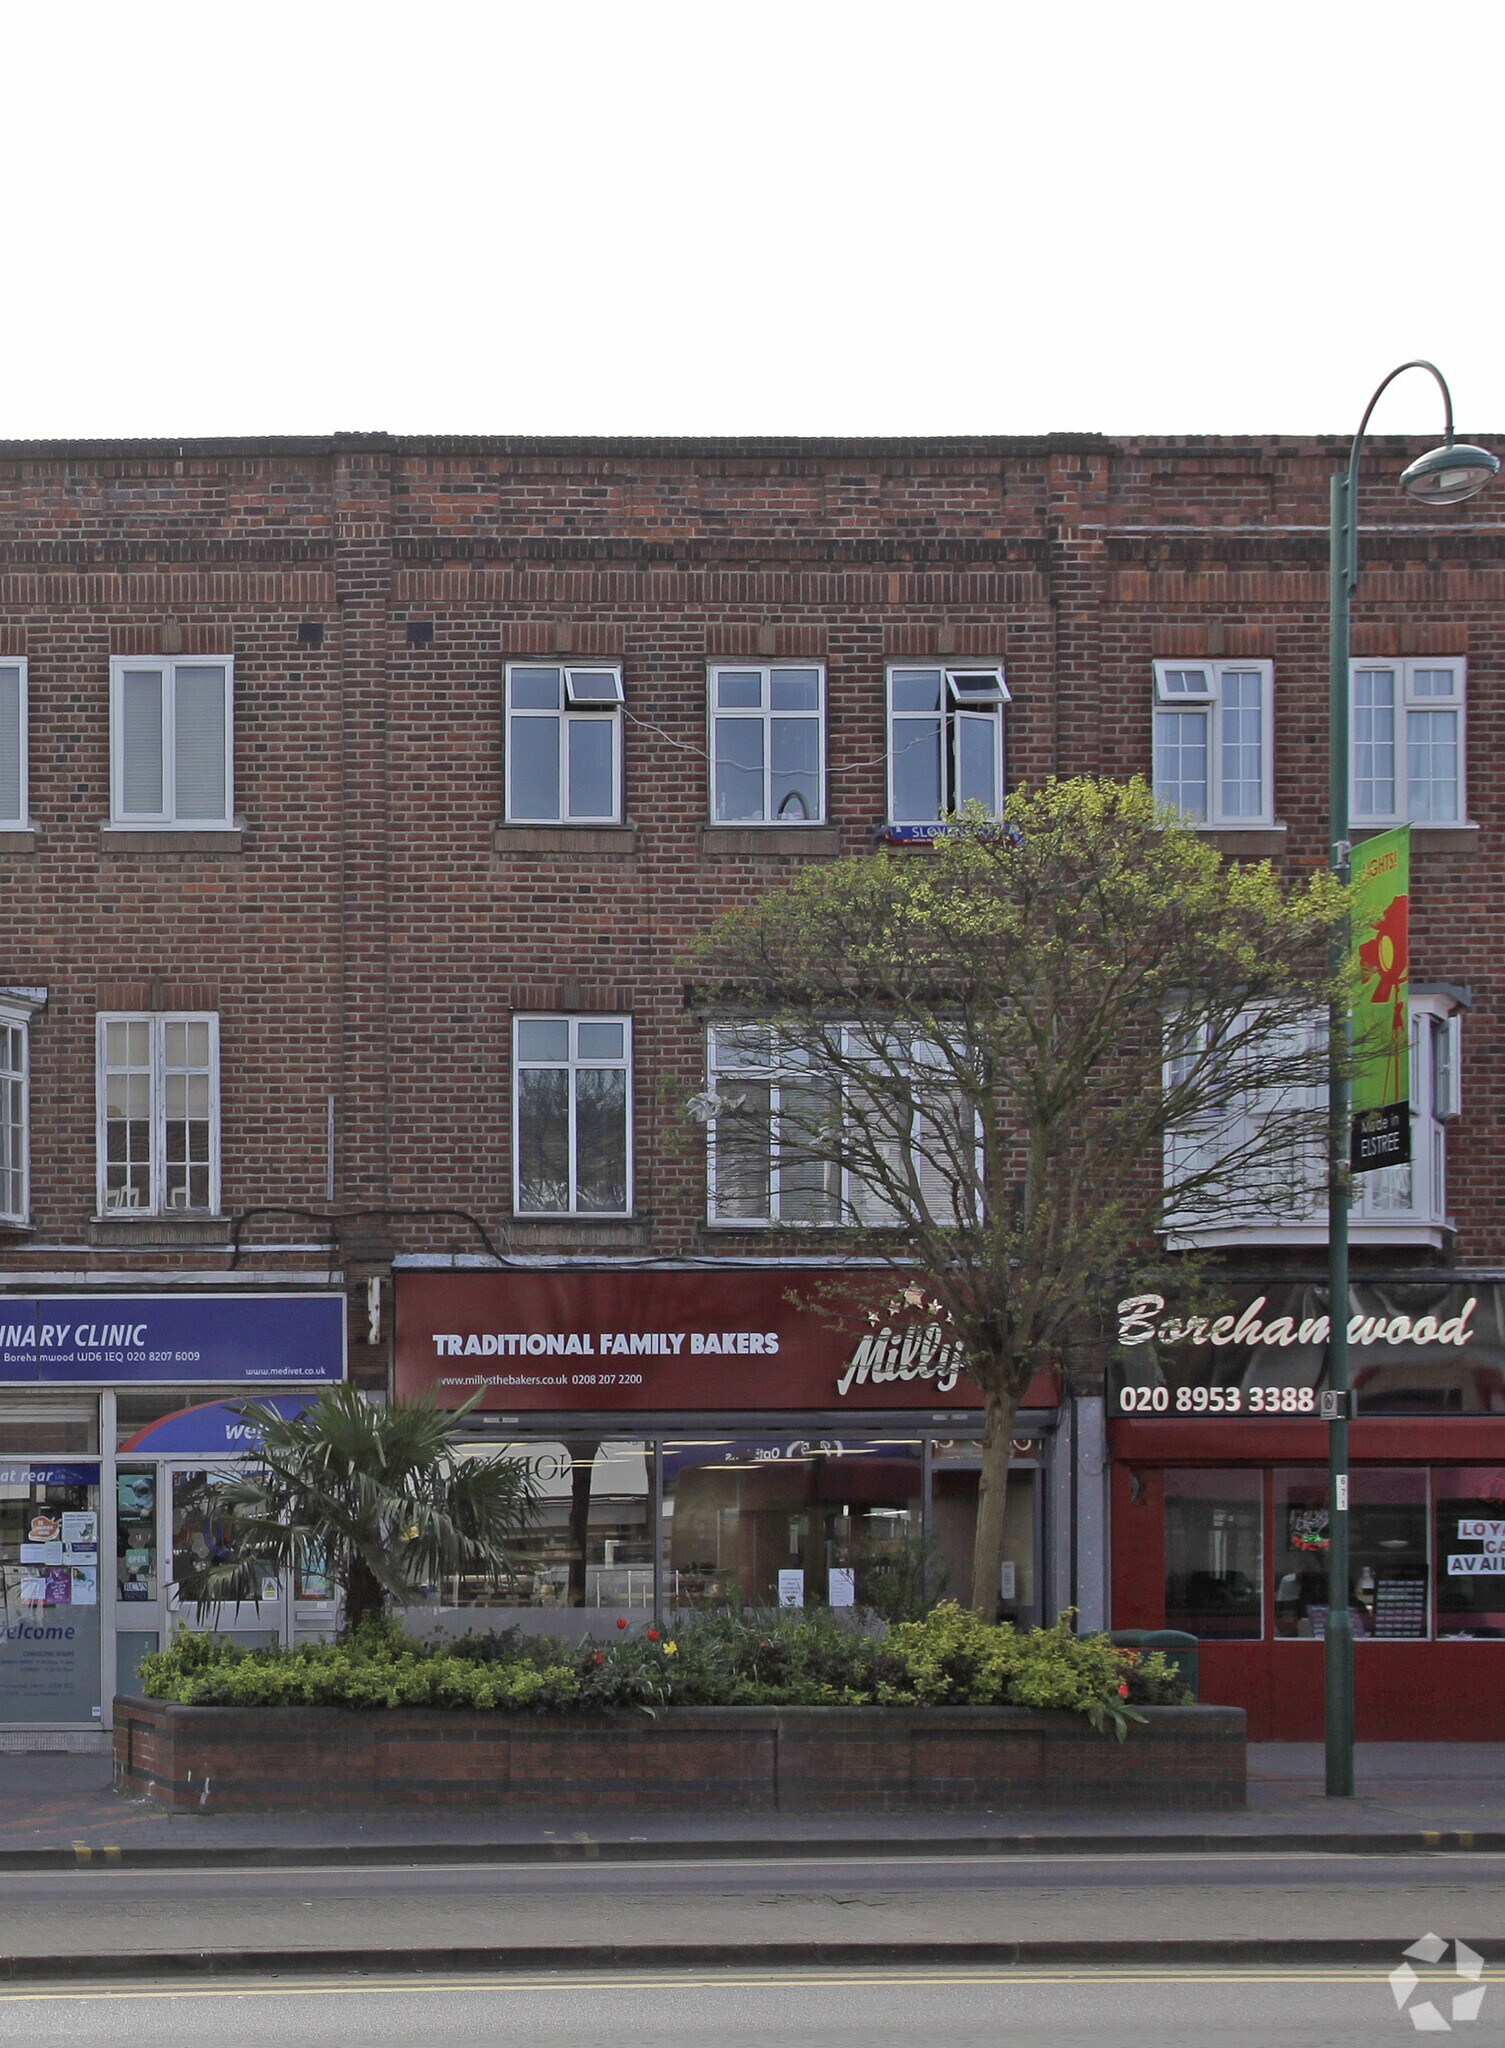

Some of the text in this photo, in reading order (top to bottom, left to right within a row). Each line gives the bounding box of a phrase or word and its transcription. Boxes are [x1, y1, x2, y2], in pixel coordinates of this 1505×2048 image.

[1361, 1131, 1399, 1157] ELSTREE
[1117, 1294, 1477, 1348] Borehamwood
[74, 1324, 148, 1347] CLINIC
[432, 1332, 780, 1356] TRADITIONAL FAMILY BAKERS
[77, 1351, 102, 1361] WD6
[105, 1351, 124, 1363] 1EQ
[127, 1351, 146, 1361] 020
[149, 1351, 172, 1361] 8207
[175, 1351, 200, 1361] 6009
[245, 1366, 326, 1376] www.medivet.co.uk
[572, 1373, 597, 1385] 0208
[598, 1373, 617, 1385] 207
[618, 1373, 643, 1385] 2200
[1119, 1386, 1315, 1412] 020 8953 3388
[0, 1469, 17, 1483] at
[20, 1470, 54, 1482] rear
[1462, 1522, 1505, 1536] LOY
[128, 1555, 148, 1564] OPEN
